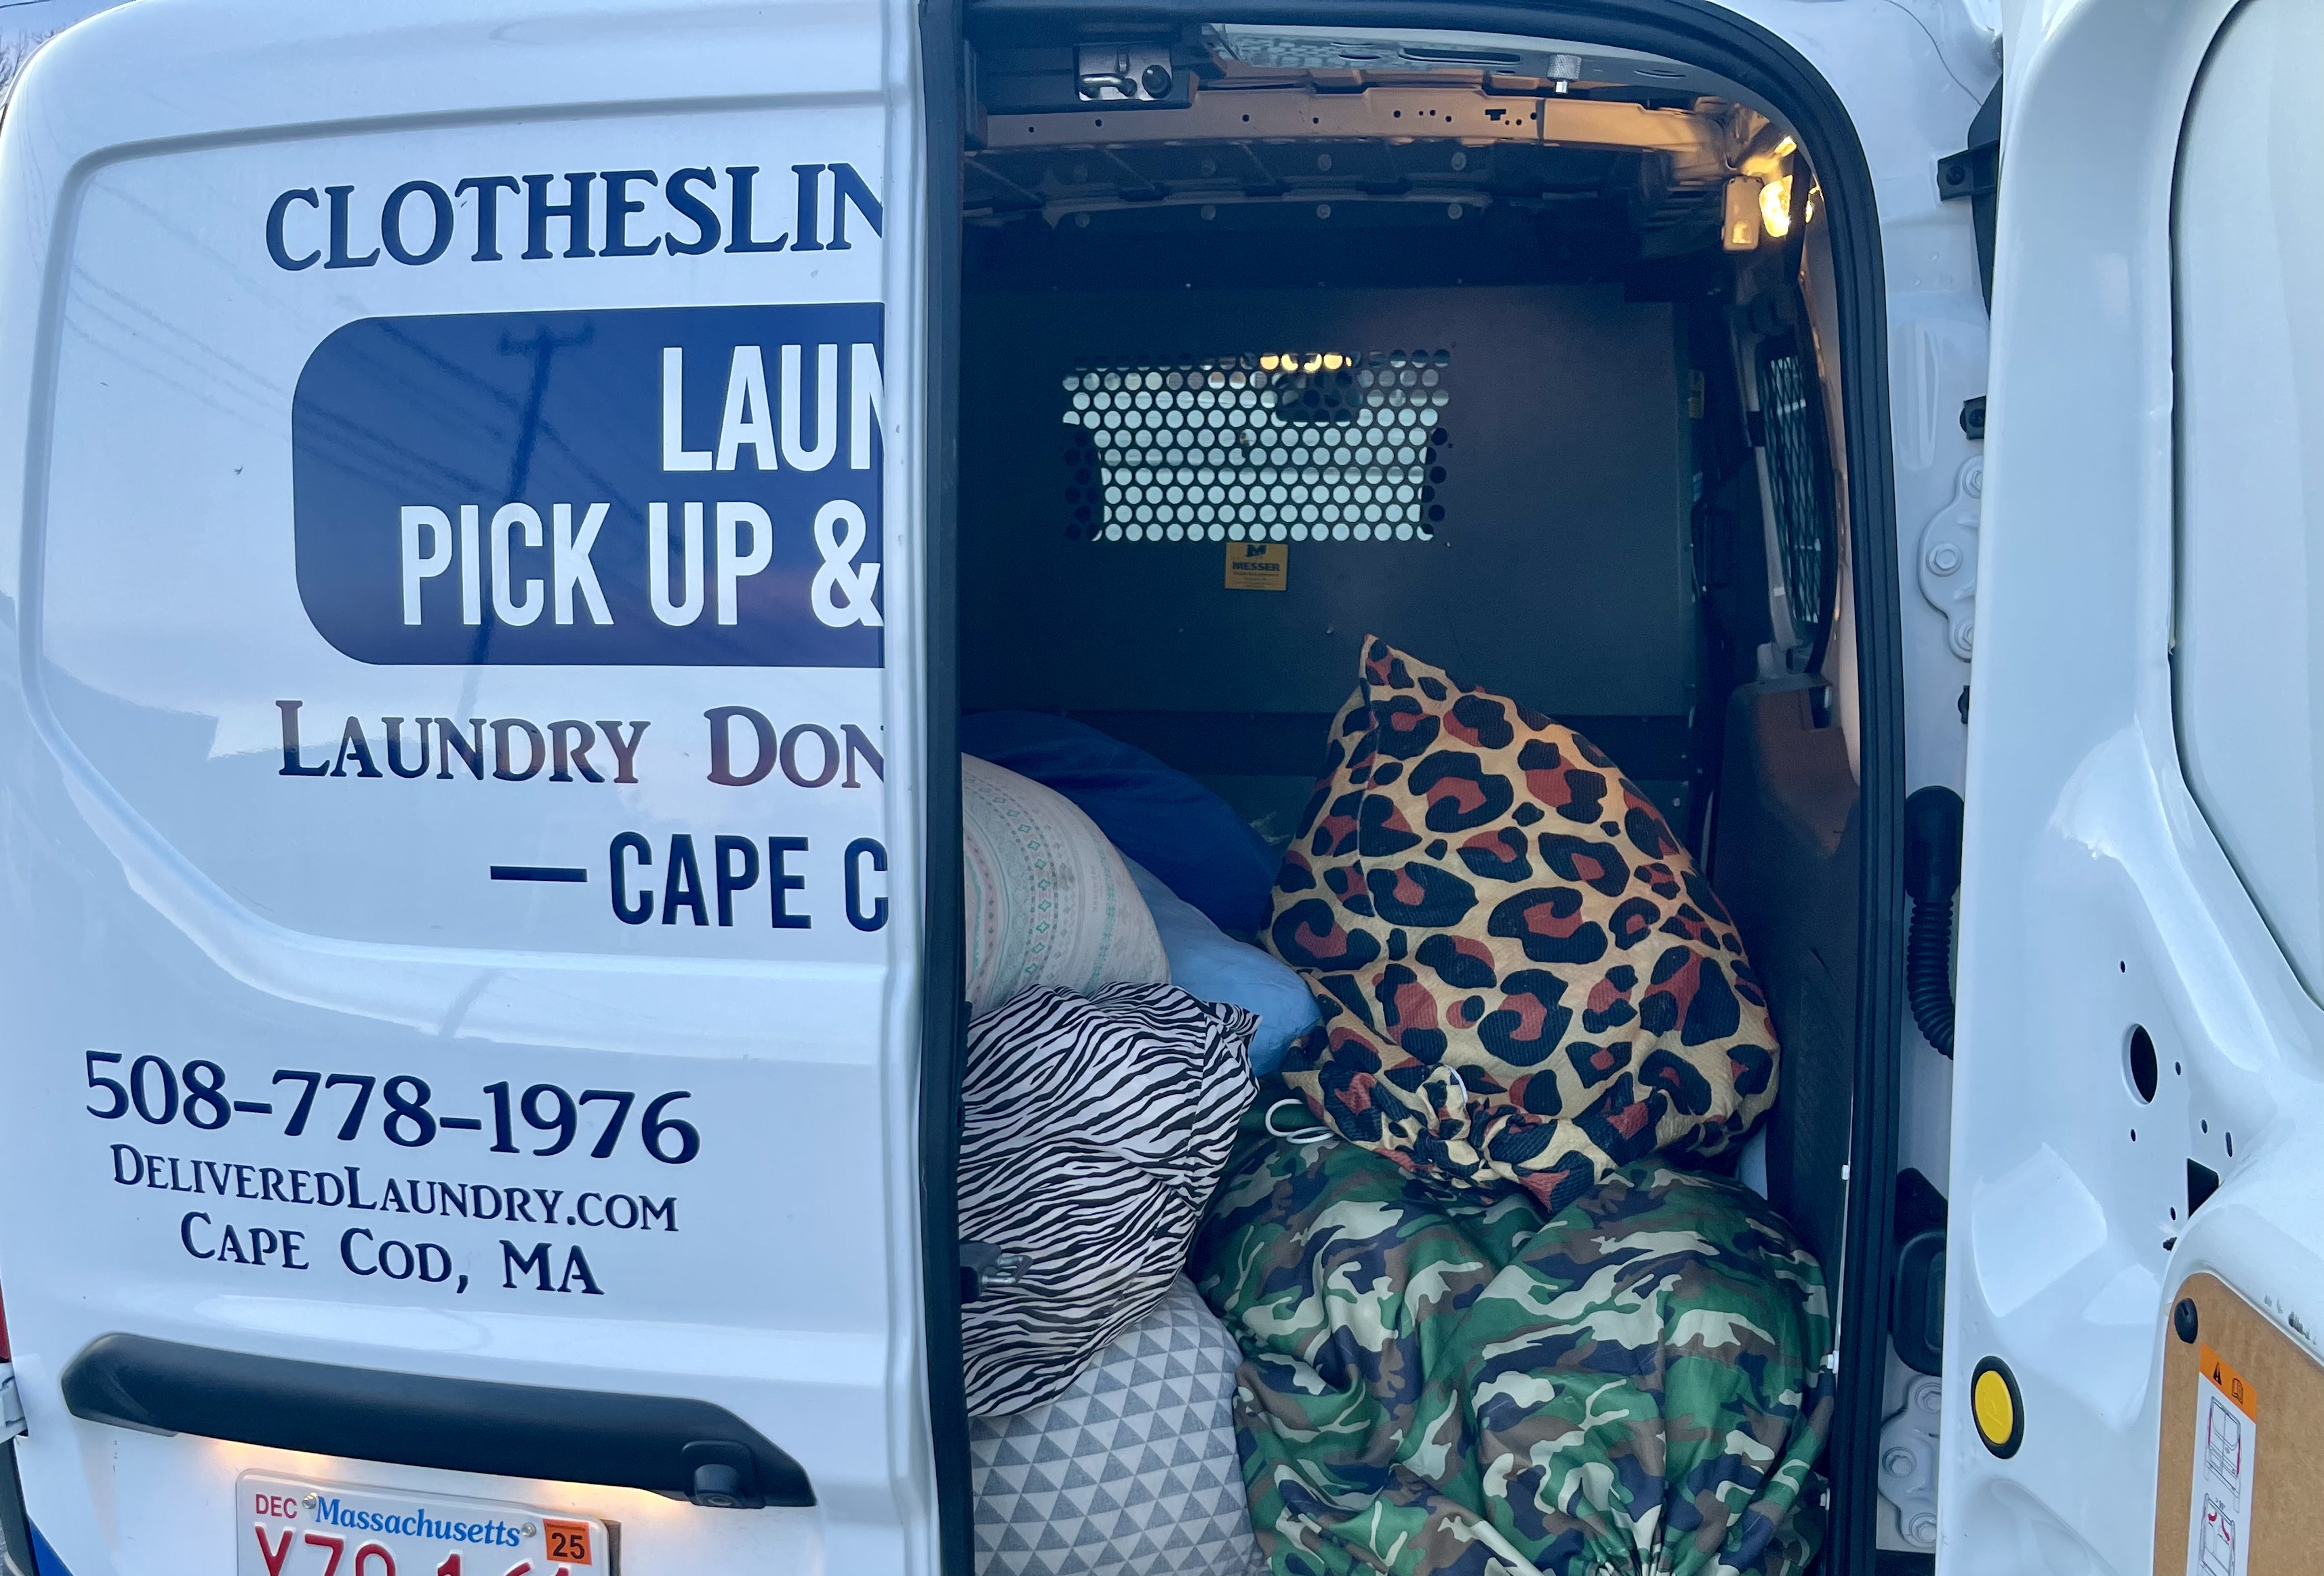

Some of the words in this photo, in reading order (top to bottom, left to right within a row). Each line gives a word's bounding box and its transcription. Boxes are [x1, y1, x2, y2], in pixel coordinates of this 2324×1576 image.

[401, 503, 614, 626] PICK
[649, 501, 773, 626] UP
[811, 500, 885, 627] &
[1233, 562, 1280, 571] MESSER
[275, 700, 652, 784] LAUNDRY
[609, 831, 812, 929] CAPE
[844, 838, 889, 932] C
[84, 1049, 702, 1165] 508-778-1976
[502, 1240, 606, 1297] MA
[255, 1493, 298, 1519] DEC
[315, 1495, 521, 1547] Massachusetts
[551, 1532, 585, 1560] 25
